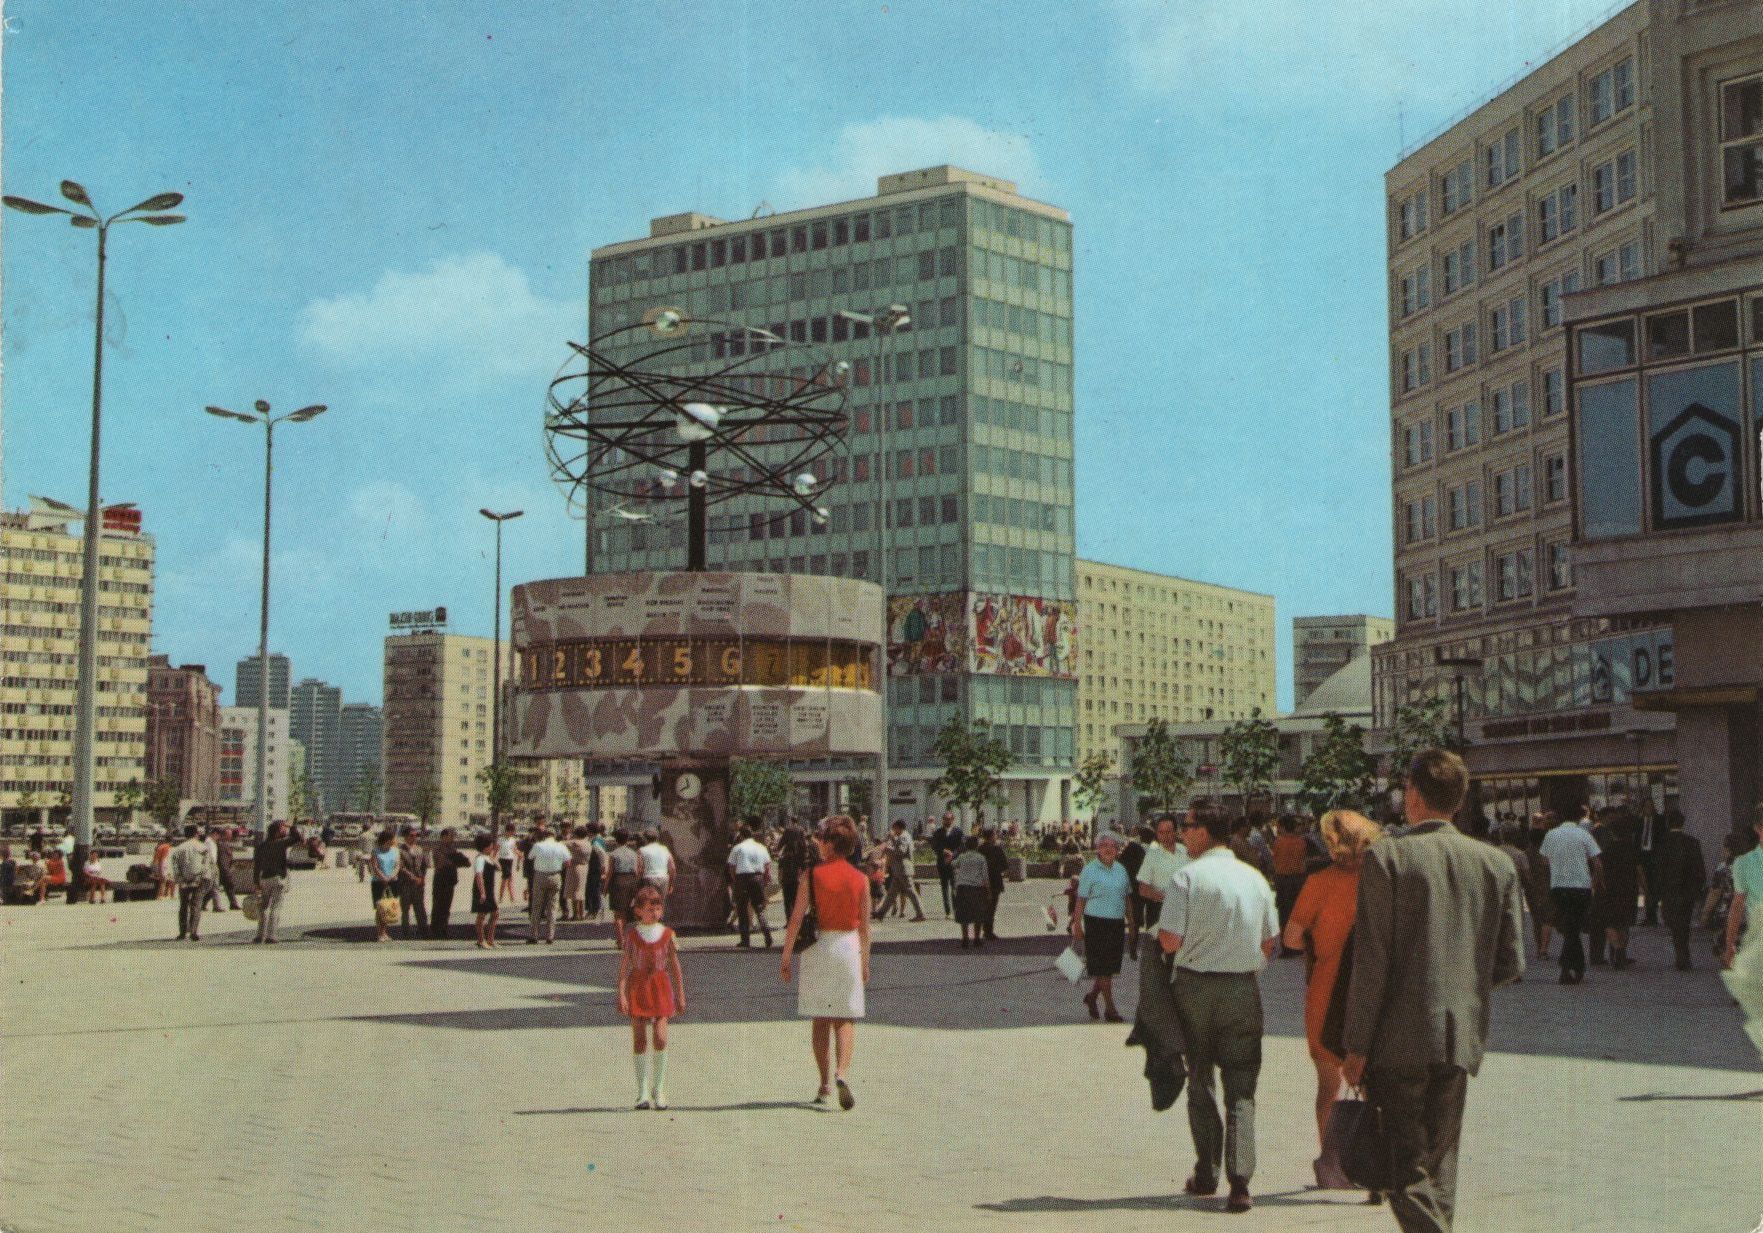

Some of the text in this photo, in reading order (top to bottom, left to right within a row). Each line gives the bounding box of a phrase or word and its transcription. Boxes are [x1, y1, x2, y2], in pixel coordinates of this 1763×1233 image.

[553, 651, 566, 679] 2
[584, 649, 602, 677] 3
[622, 648, 645, 676] 4
[673, 647, 694, 676] 5
